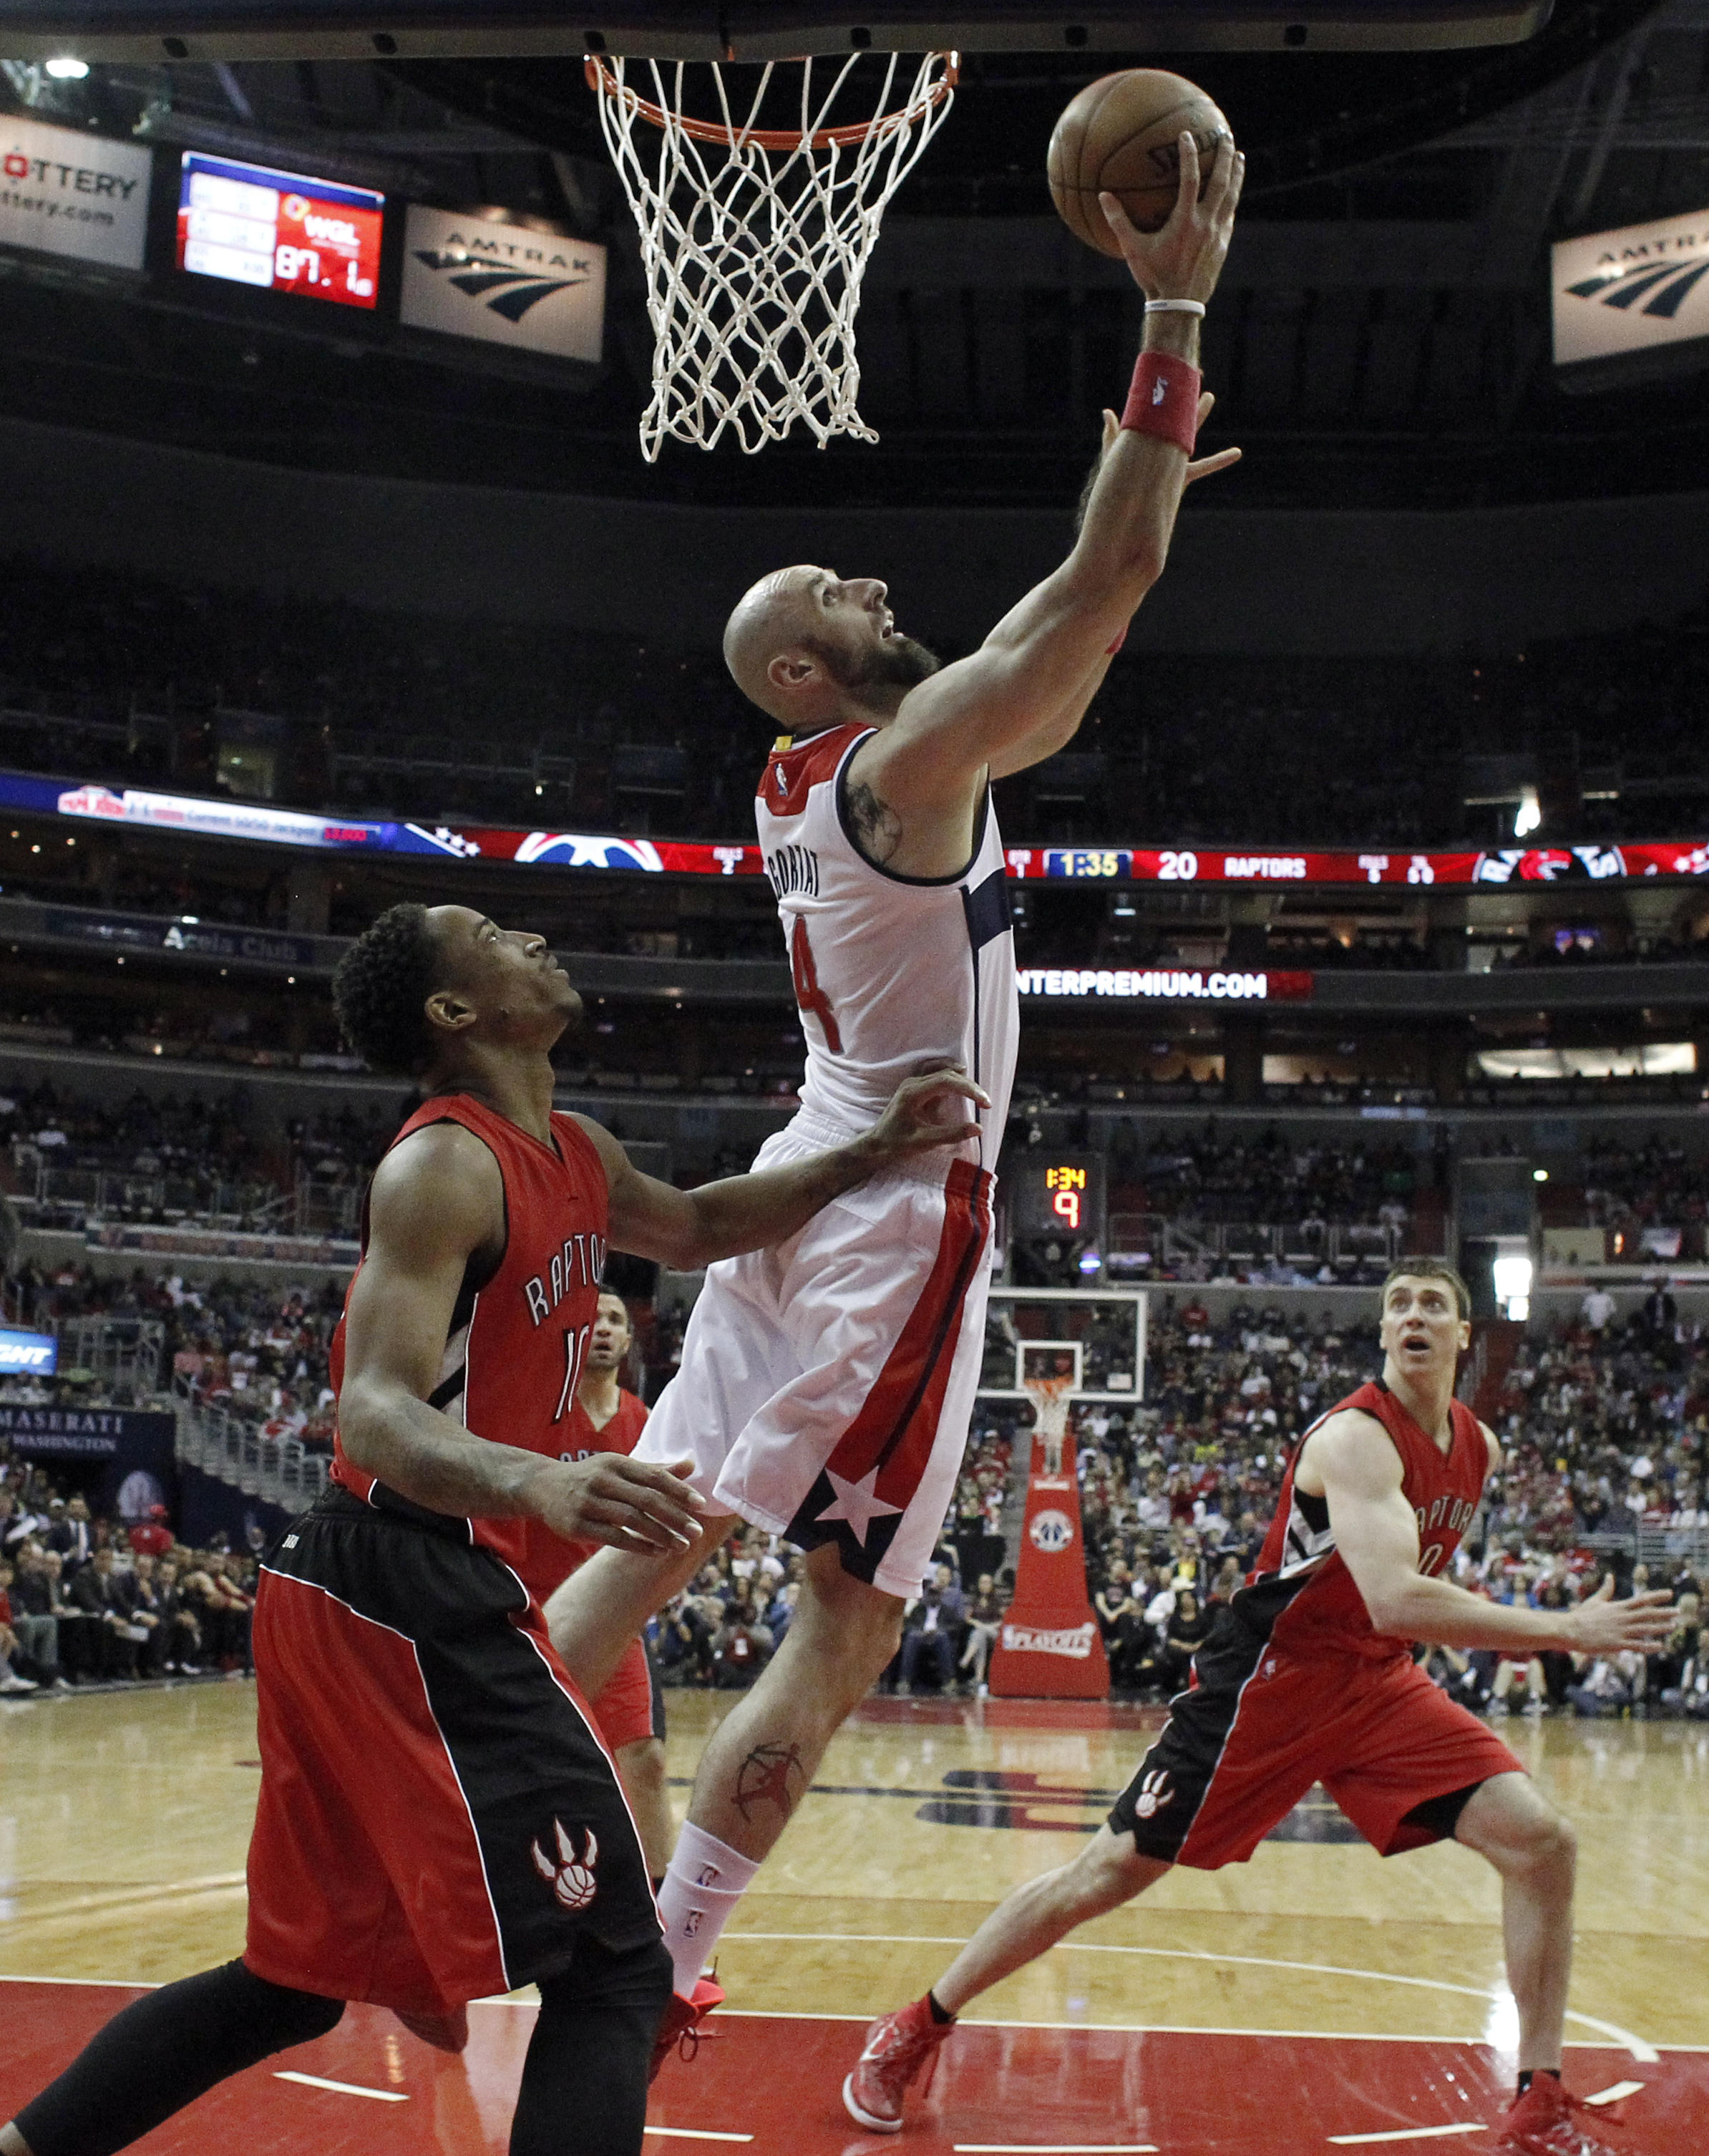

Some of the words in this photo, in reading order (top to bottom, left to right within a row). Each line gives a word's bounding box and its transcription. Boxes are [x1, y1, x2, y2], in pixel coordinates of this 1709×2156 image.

[447, 232, 591, 275] AMTRAK
[1596, 233, 1709, 267] AMTR
[768, 845, 819, 901] GORTAT
[1061, 853, 1119, 876] 1:35
[1158, 851, 1198, 880] 20
[1224, 856, 1306, 878] RAPTORS
[792, 913, 844, 1055] 4
[1046, 1166, 1086, 1190] 1:34
[1053, 1191, 1080, 1228] 9
